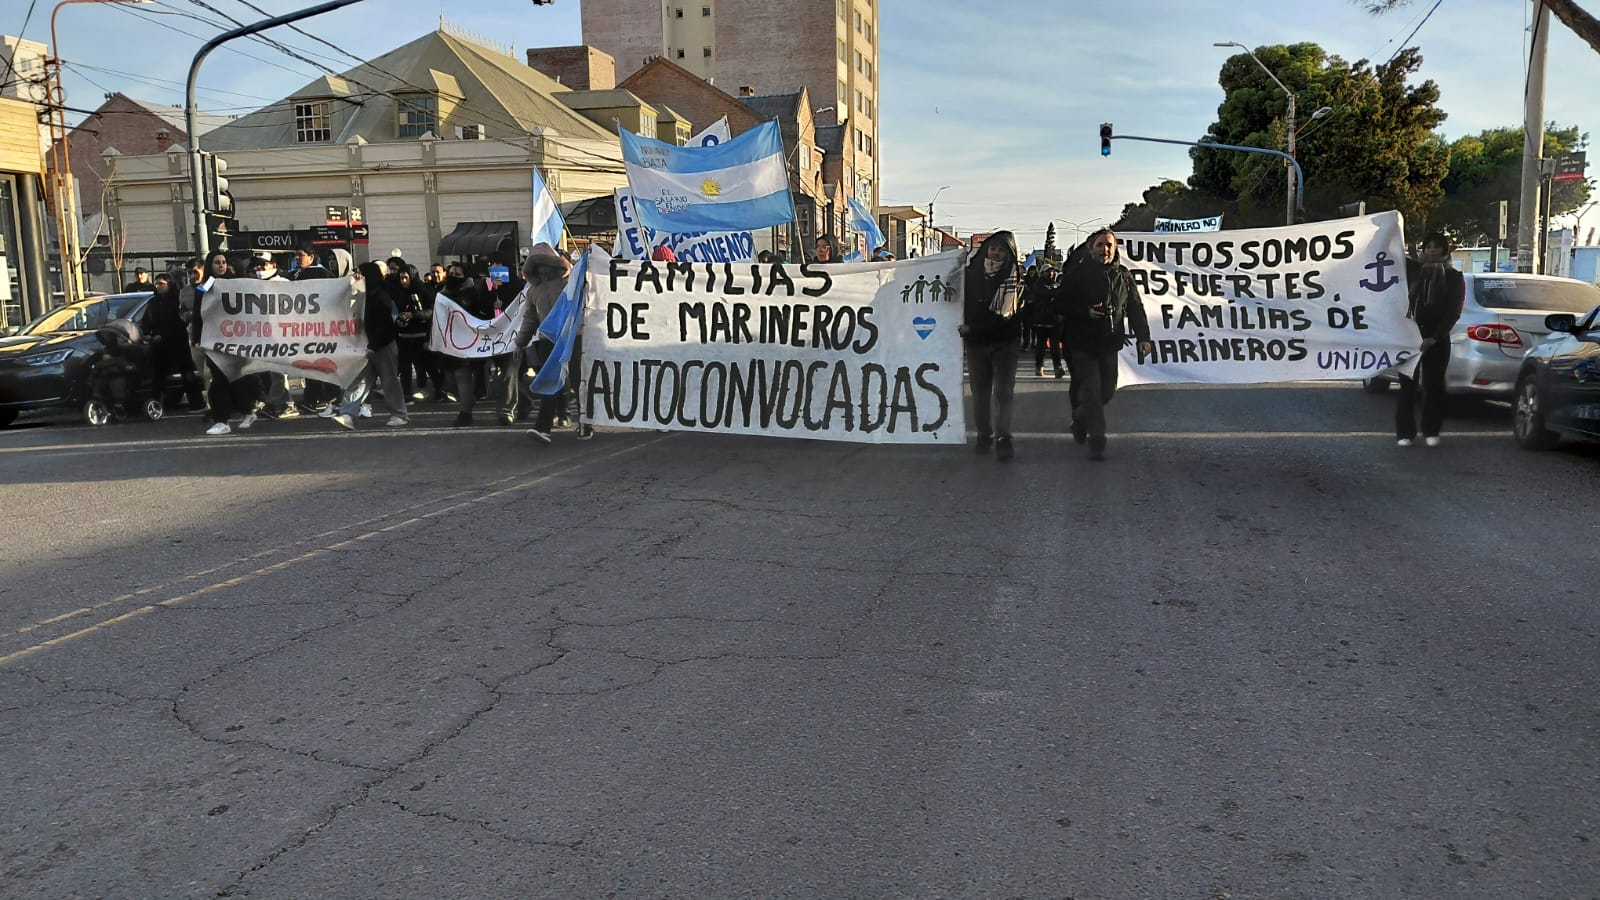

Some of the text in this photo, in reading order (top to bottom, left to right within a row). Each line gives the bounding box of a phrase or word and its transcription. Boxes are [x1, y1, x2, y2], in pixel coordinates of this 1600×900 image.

[1202, 218, 1217, 227] NO
[257, 235, 293, 247] CORVI
[1238, 230, 1356, 270] SOMOS
[608, 258, 834, 298] FAMILIAS
[221, 292, 321, 316] UNIDOS
[219, 319, 273, 338] COMO
[606, 301, 879, 354] DE MARINEROS
[1327, 304, 1369, 330] DE
[303, 341, 338, 355] CON
[586, 358, 950, 435] AUTOCONVOCADAS
